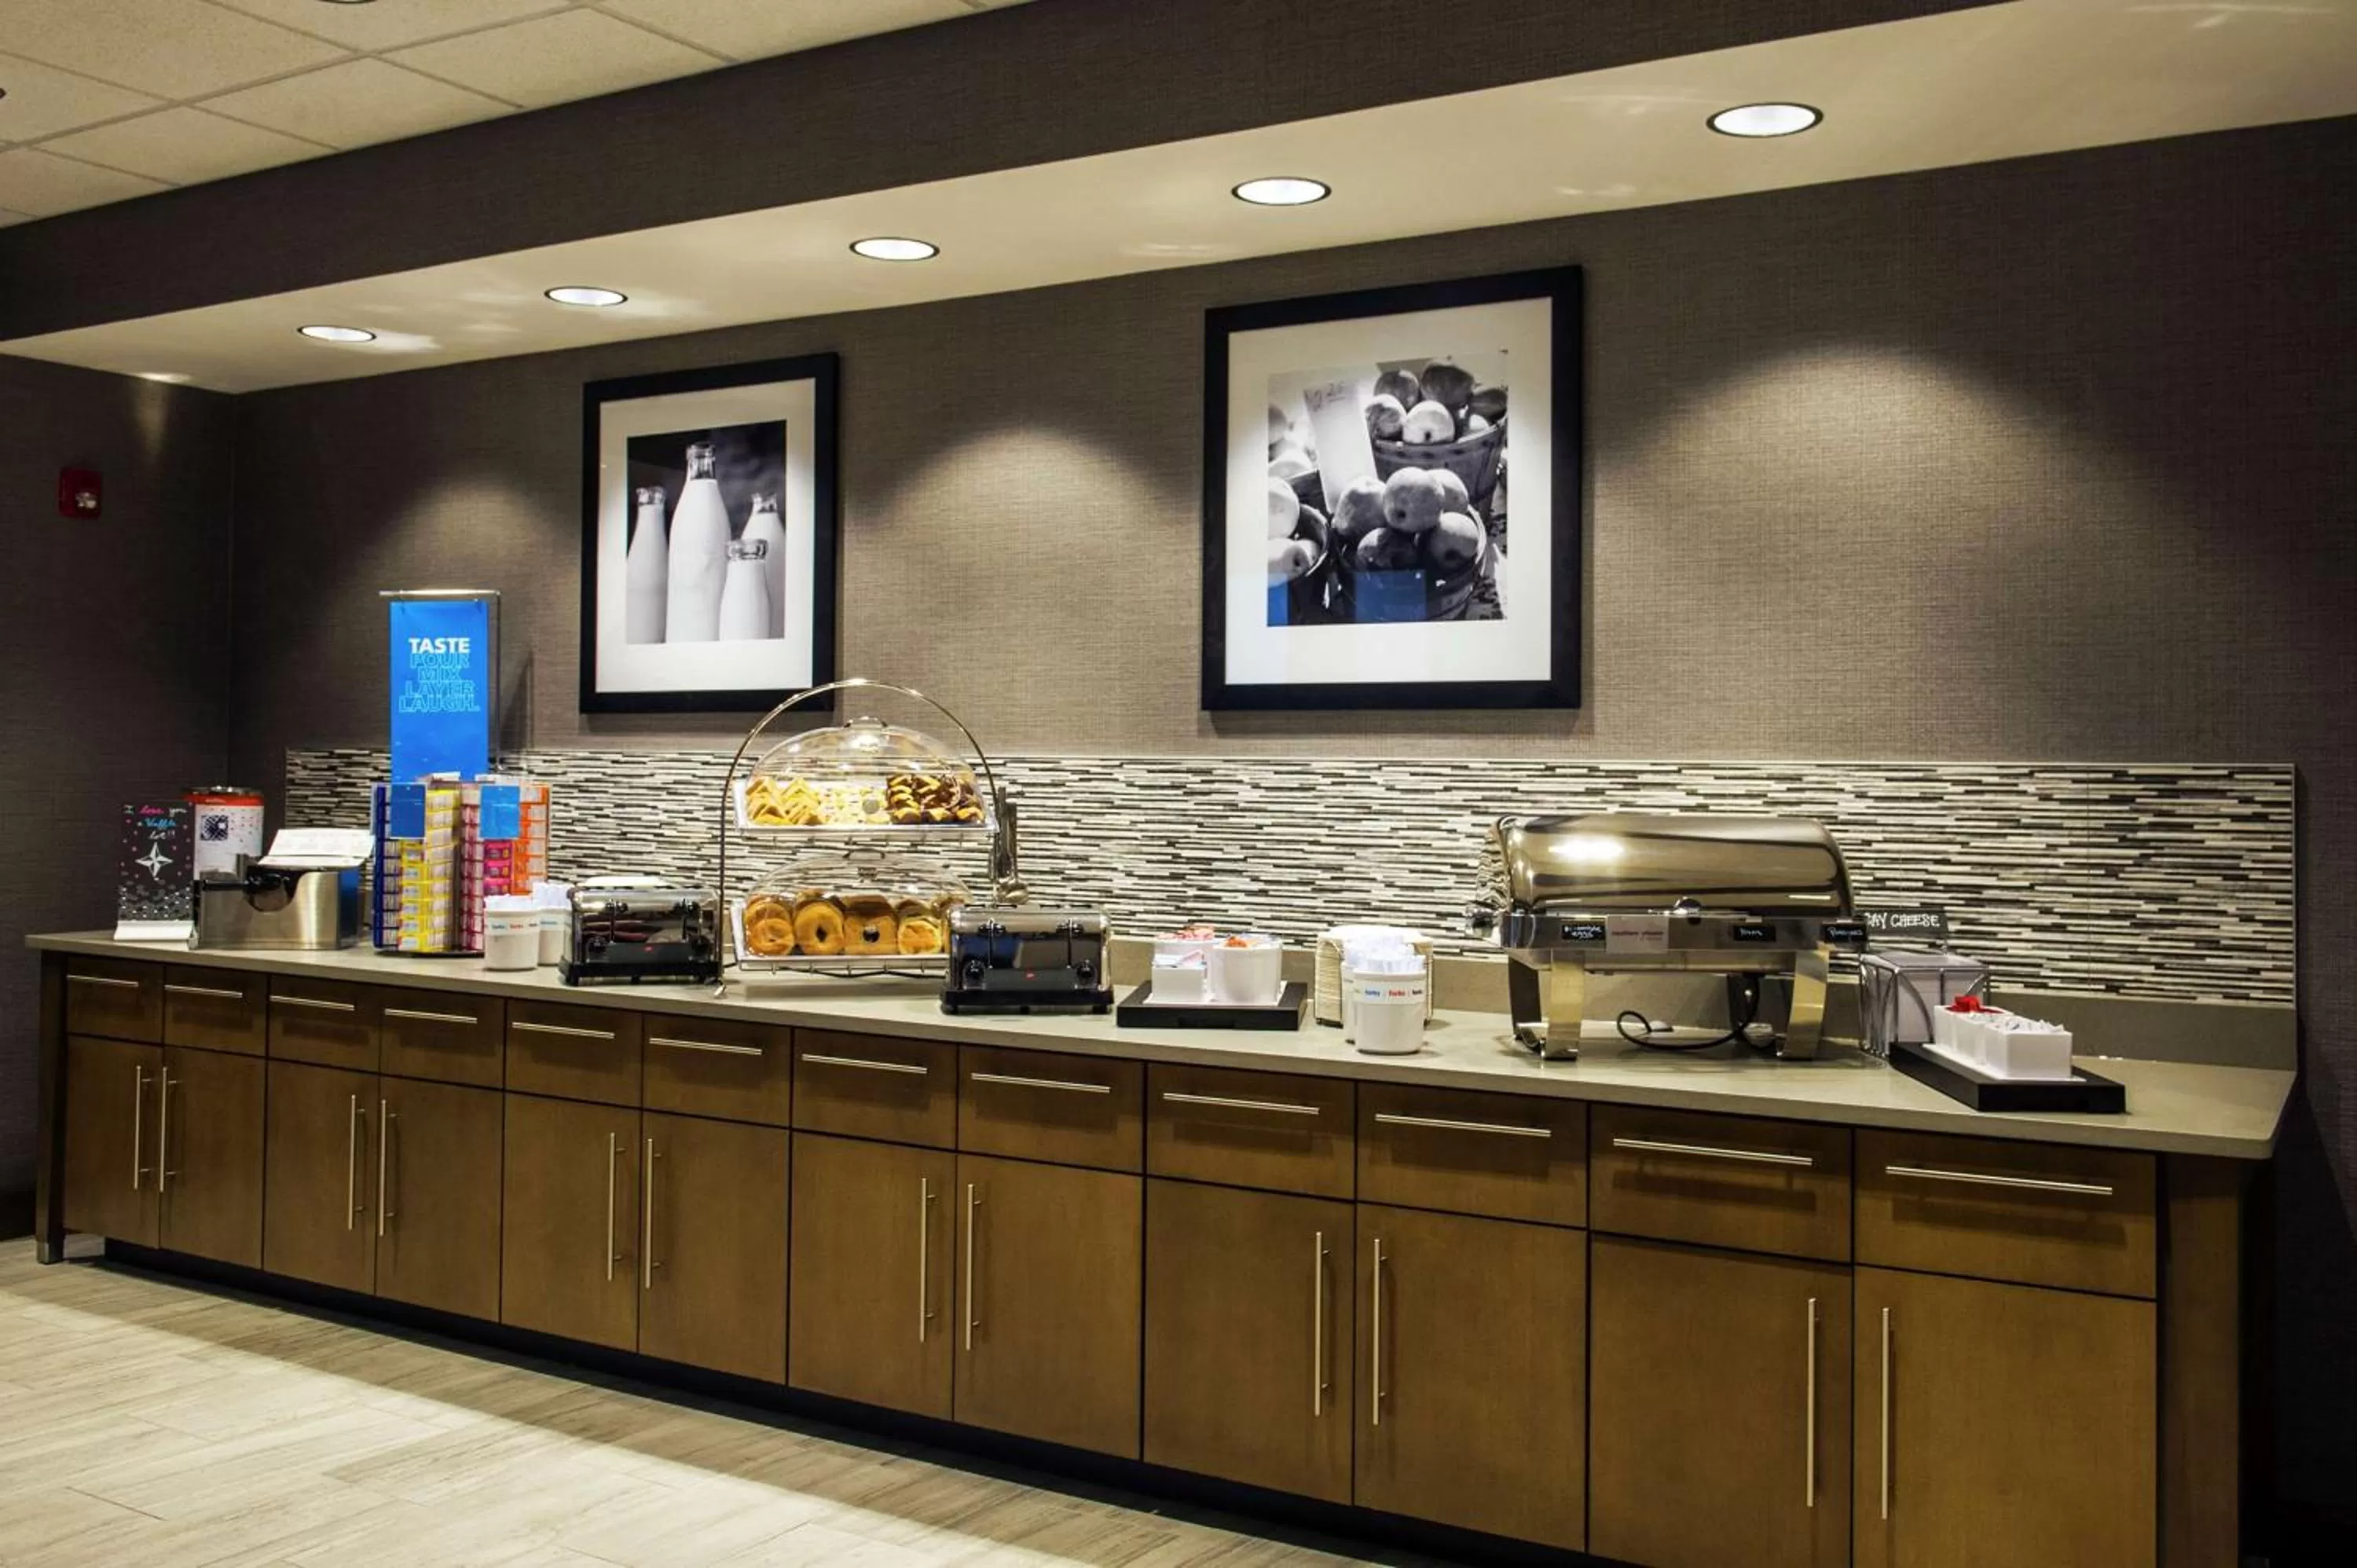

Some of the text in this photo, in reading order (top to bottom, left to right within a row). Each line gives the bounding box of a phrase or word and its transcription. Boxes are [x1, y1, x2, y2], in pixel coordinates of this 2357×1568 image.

[409, 637, 470, 654] TASTE
[409, 653, 470, 669] POUR
[417, 666, 462, 682] MIX
[405, 680, 475, 698] LAYER
[1890, 914, 1940, 928] CHEESE
